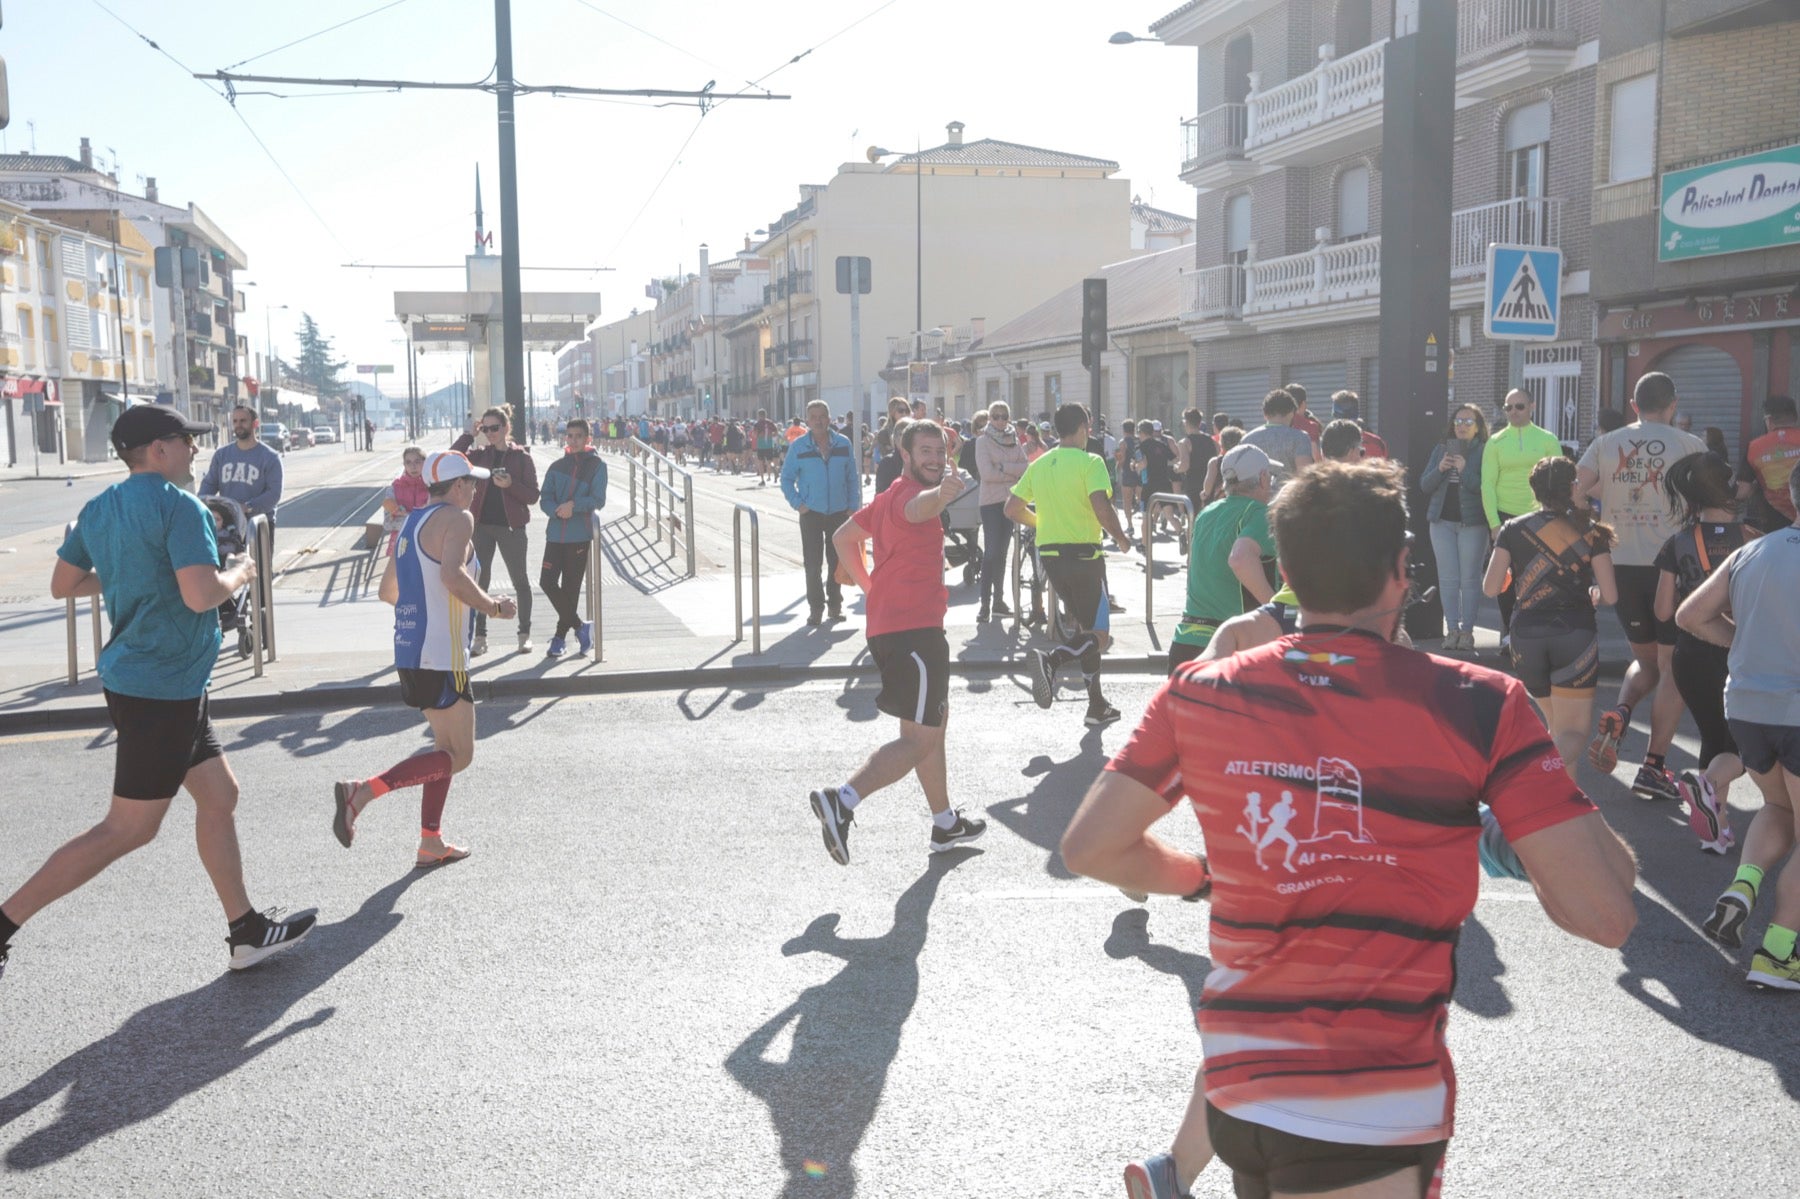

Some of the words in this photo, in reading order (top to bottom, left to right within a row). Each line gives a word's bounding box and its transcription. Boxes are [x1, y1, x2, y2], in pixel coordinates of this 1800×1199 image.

[1621, 314, 1653, 330] Café
[1628, 439, 1666, 456] YO
[221, 462, 260, 486] GAP
[1224, 760, 1316, 781] ATLETISMO
